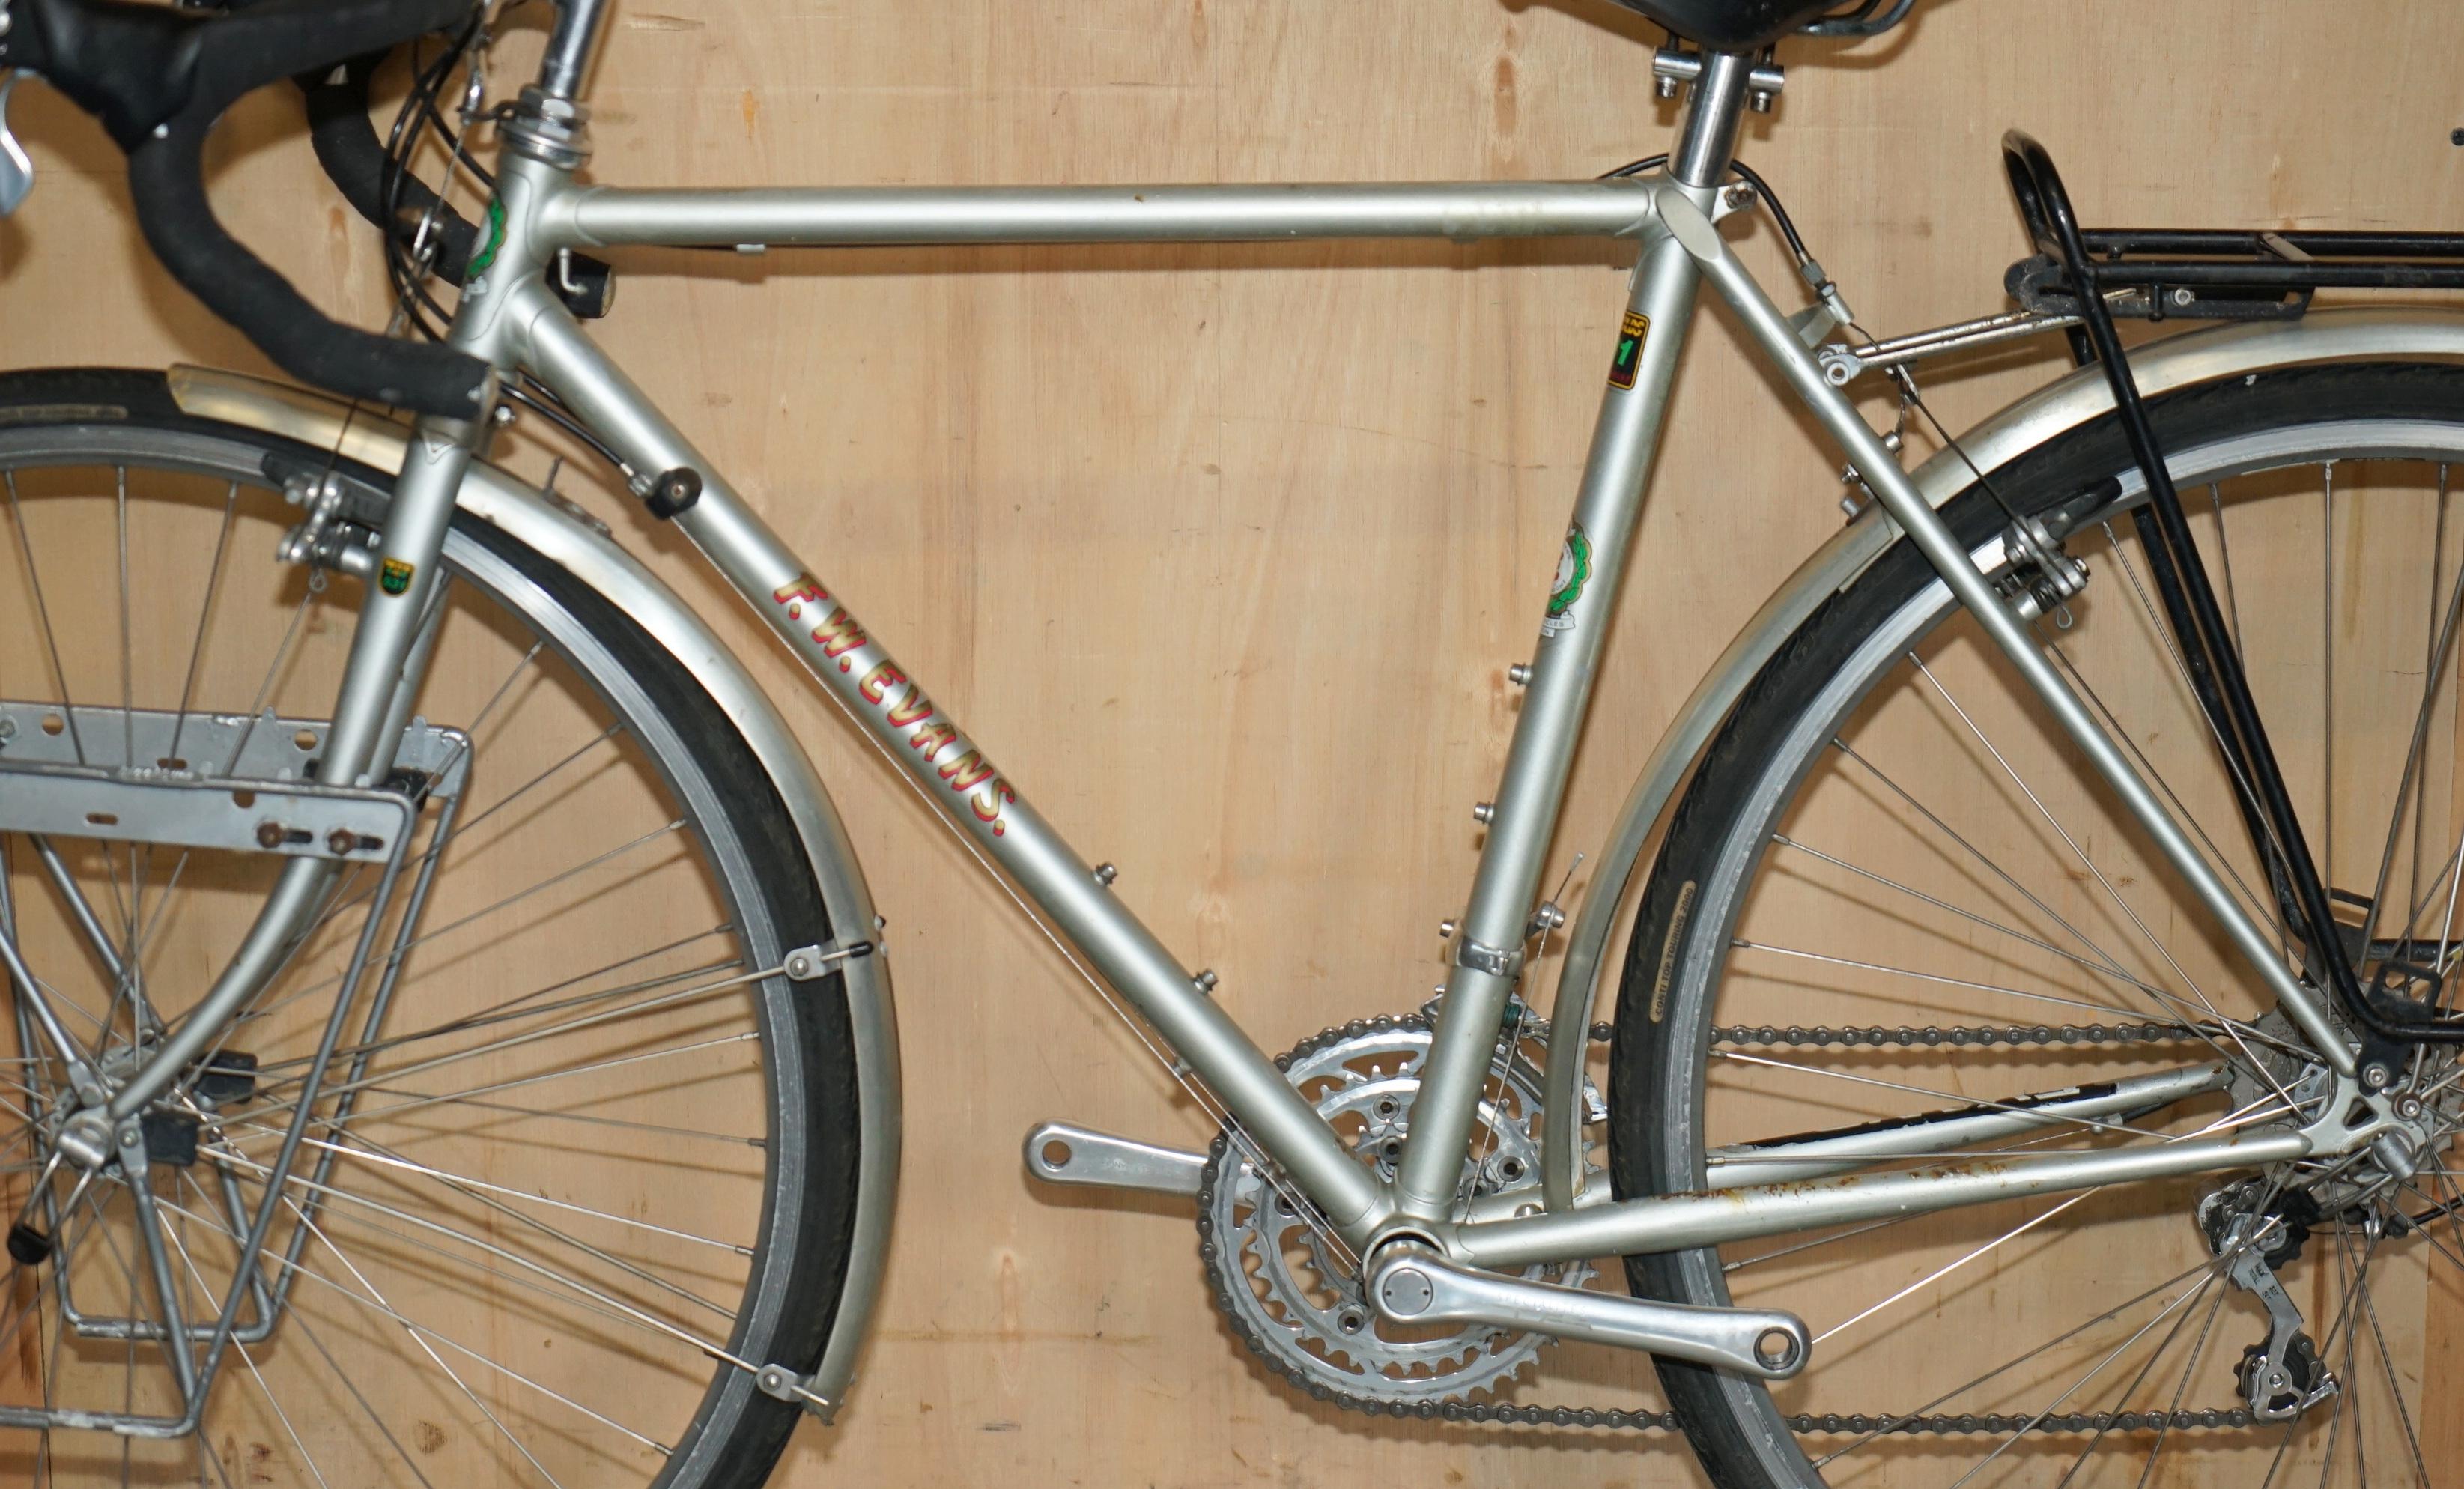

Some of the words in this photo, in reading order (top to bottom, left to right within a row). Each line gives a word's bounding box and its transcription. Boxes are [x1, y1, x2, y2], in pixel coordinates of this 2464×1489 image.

[1681, 888, 1693, 912] 2000
[1667, 916, 1684, 959] TOURING
[1661, 961, 1672, 983] TOP
[1655, 985, 1668, 1015] CONTI
